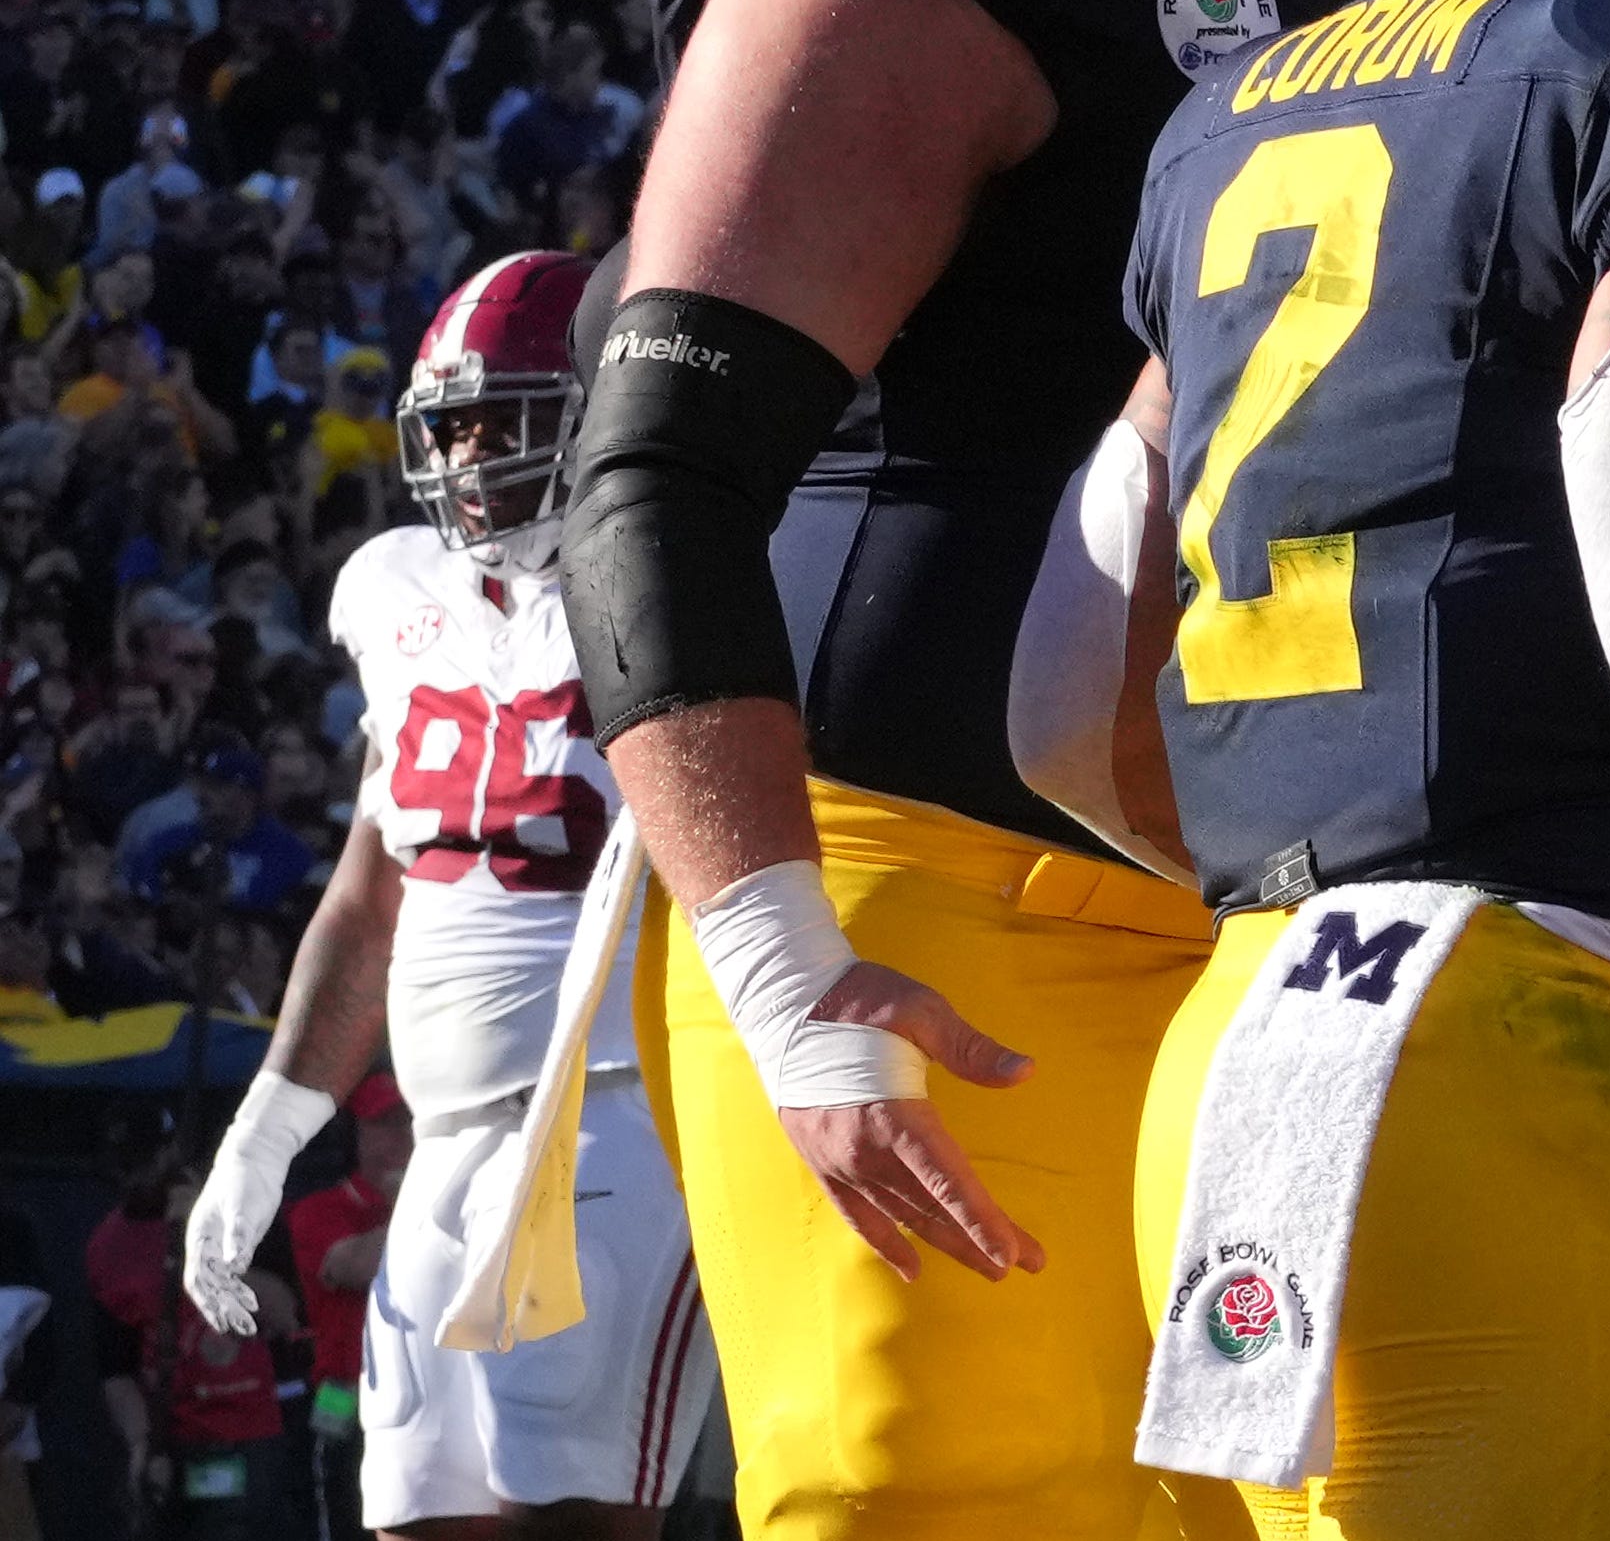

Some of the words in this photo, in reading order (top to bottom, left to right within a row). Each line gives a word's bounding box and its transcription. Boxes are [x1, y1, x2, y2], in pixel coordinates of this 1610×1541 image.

[1178, 123, 1394, 705] 2
[390, 679, 607, 892] 96
[1283, 910, 1428, 1005] M
[1169, 1256, 1214, 1323] ROSE
[1287, 1272, 1314, 1349] GAME
